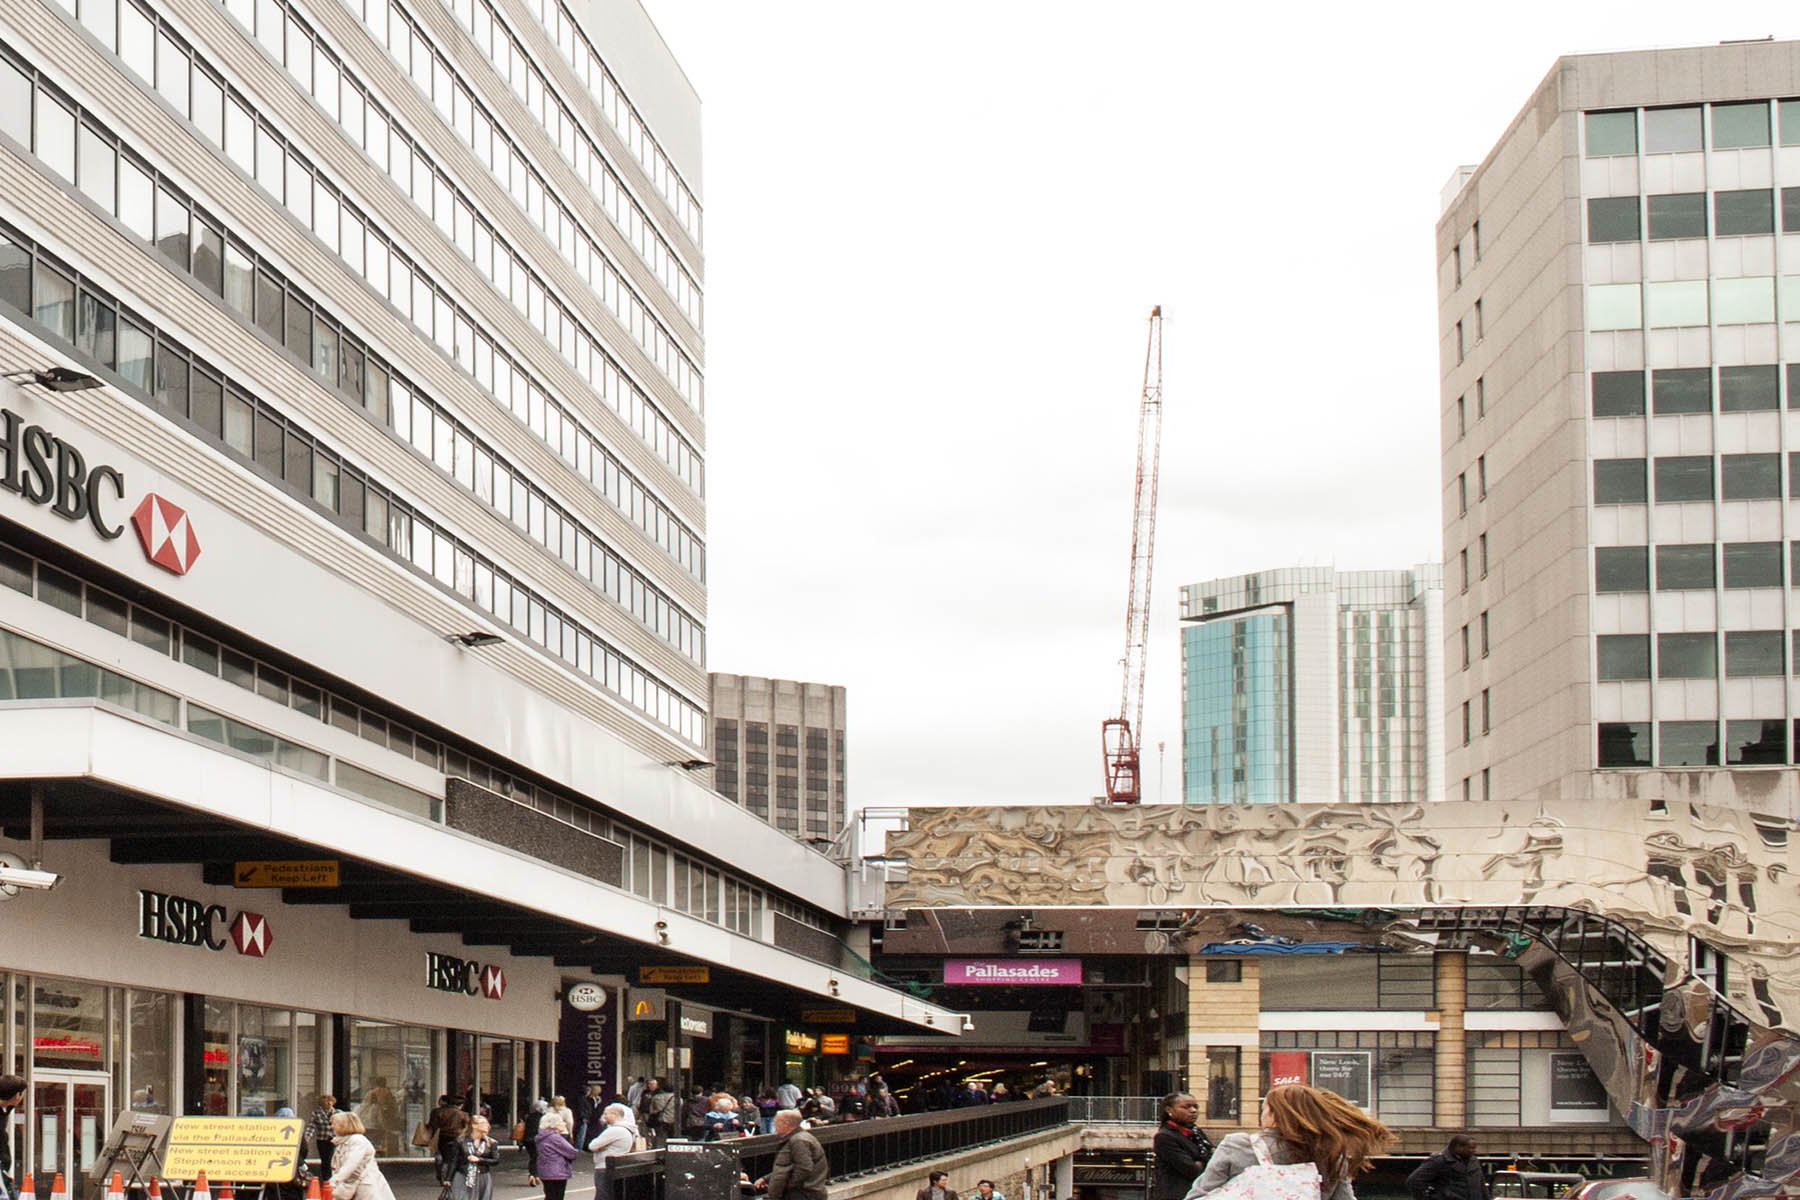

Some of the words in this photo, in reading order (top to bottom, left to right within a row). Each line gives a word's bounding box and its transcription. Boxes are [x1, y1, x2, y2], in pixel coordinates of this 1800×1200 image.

[264, 864, 335, 873] Pedestrians
[138, 889, 227, 951] HSBC
[425, 952, 479, 996] HSBC
[965, 965, 1059, 978] Pallasades
[571, 994, 601, 1003] HSBC
[587, 1014, 607, 1077] Premier
[1273, 1076, 1300, 1085] SALE
[175, 1122, 200, 1131] New
[203, 1123, 235, 1131] street
[238, 1124, 277, 1132] station
[214, 1134, 276, 1142] Pallasades
[198, 1147, 230, 1155] street
[232, 1147, 272, 1156] station
[174, 1157, 242, 1167] Stephenson
[225, 1168, 269, 1177] access)
